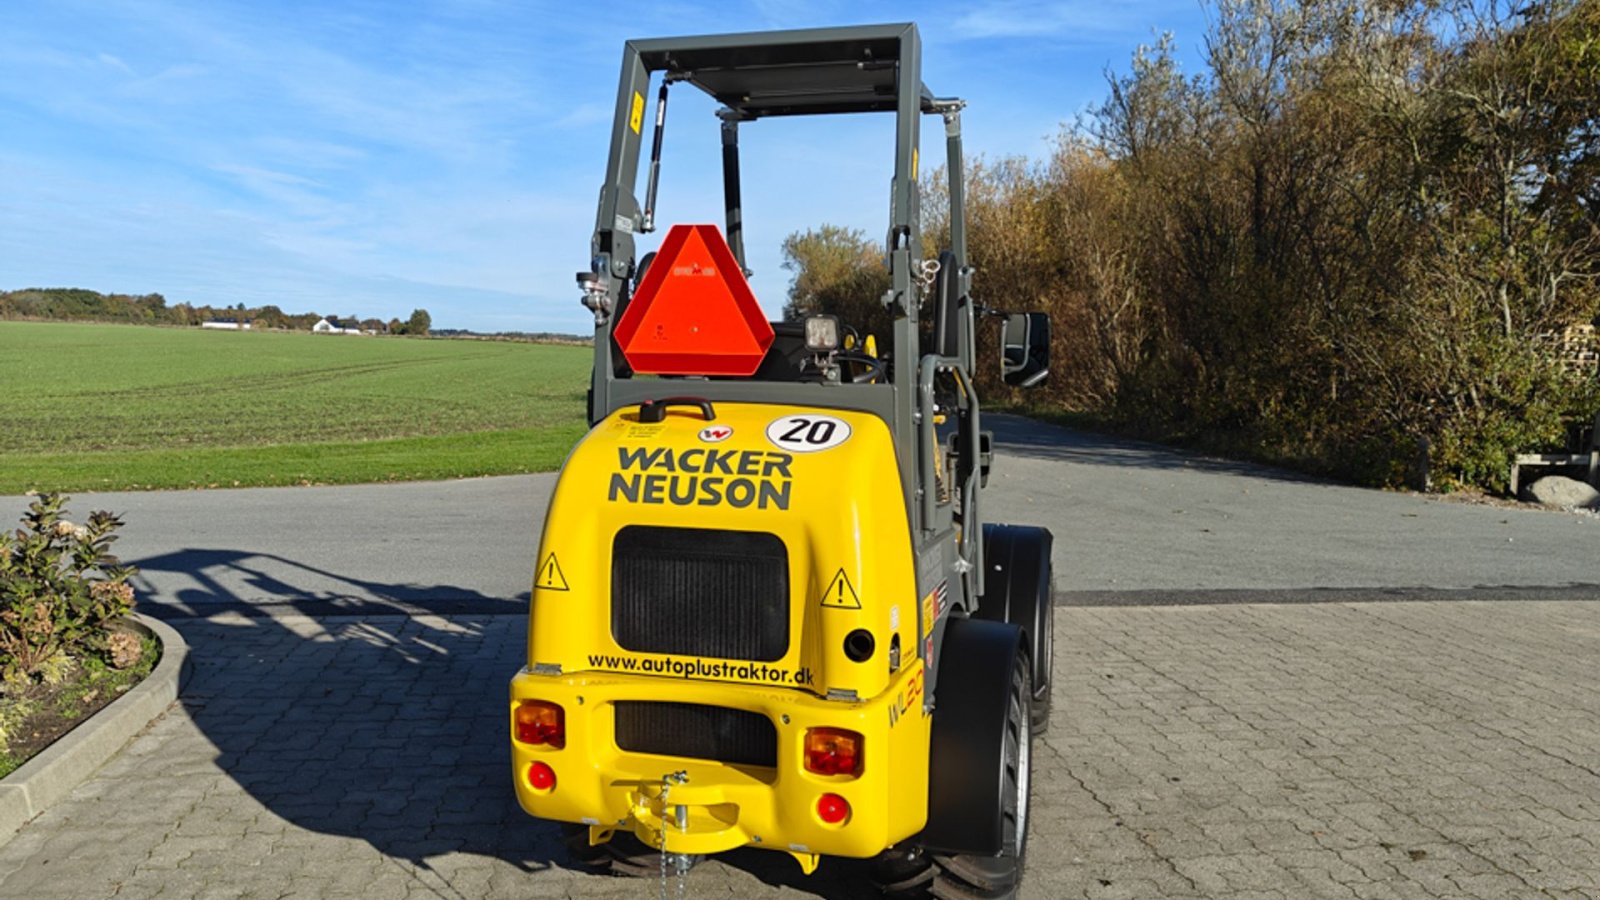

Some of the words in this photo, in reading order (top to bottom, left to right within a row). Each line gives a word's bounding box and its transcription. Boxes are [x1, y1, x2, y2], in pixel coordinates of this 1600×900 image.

[778, 418, 837, 445] 20
[618, 447, 793, 478] WACKER
[608, 473, 792, 511] NEUSON
[588, 655, 815, 686] www.autoplustraktor.dk
